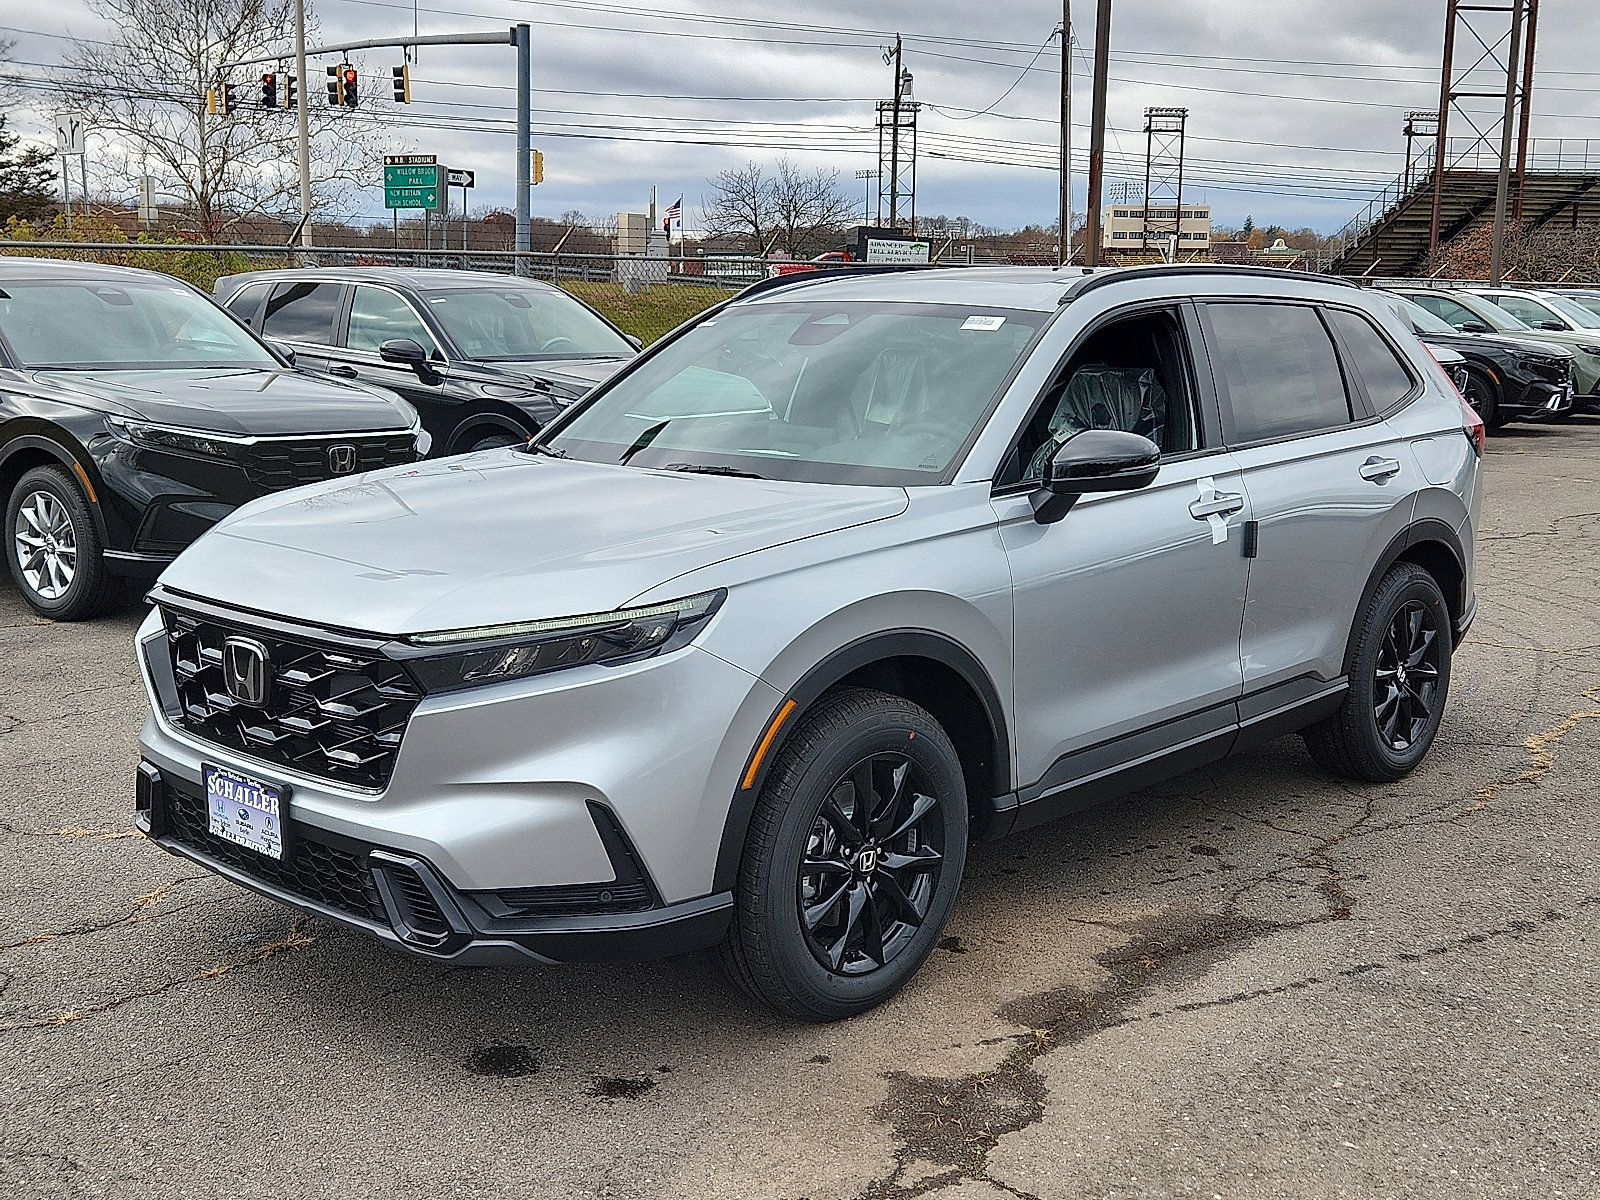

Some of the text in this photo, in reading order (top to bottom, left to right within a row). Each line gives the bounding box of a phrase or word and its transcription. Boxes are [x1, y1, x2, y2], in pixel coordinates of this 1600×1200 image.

[408, 155, 434, 164] STADIUMS
[396, 167, 435, 176] WILLOW BROOK
[408, 177, 423, 185] PARK
[451, 174, 463, 182] WAY
[389, 199, 402, 207] HIGH
[869, 241, 904, 249] ADVANCED
[207, 775, 280, 815] SCHALLER
[235, 819, 254, 830] SUBARU
[261, 828, 279, 839] ACURA
